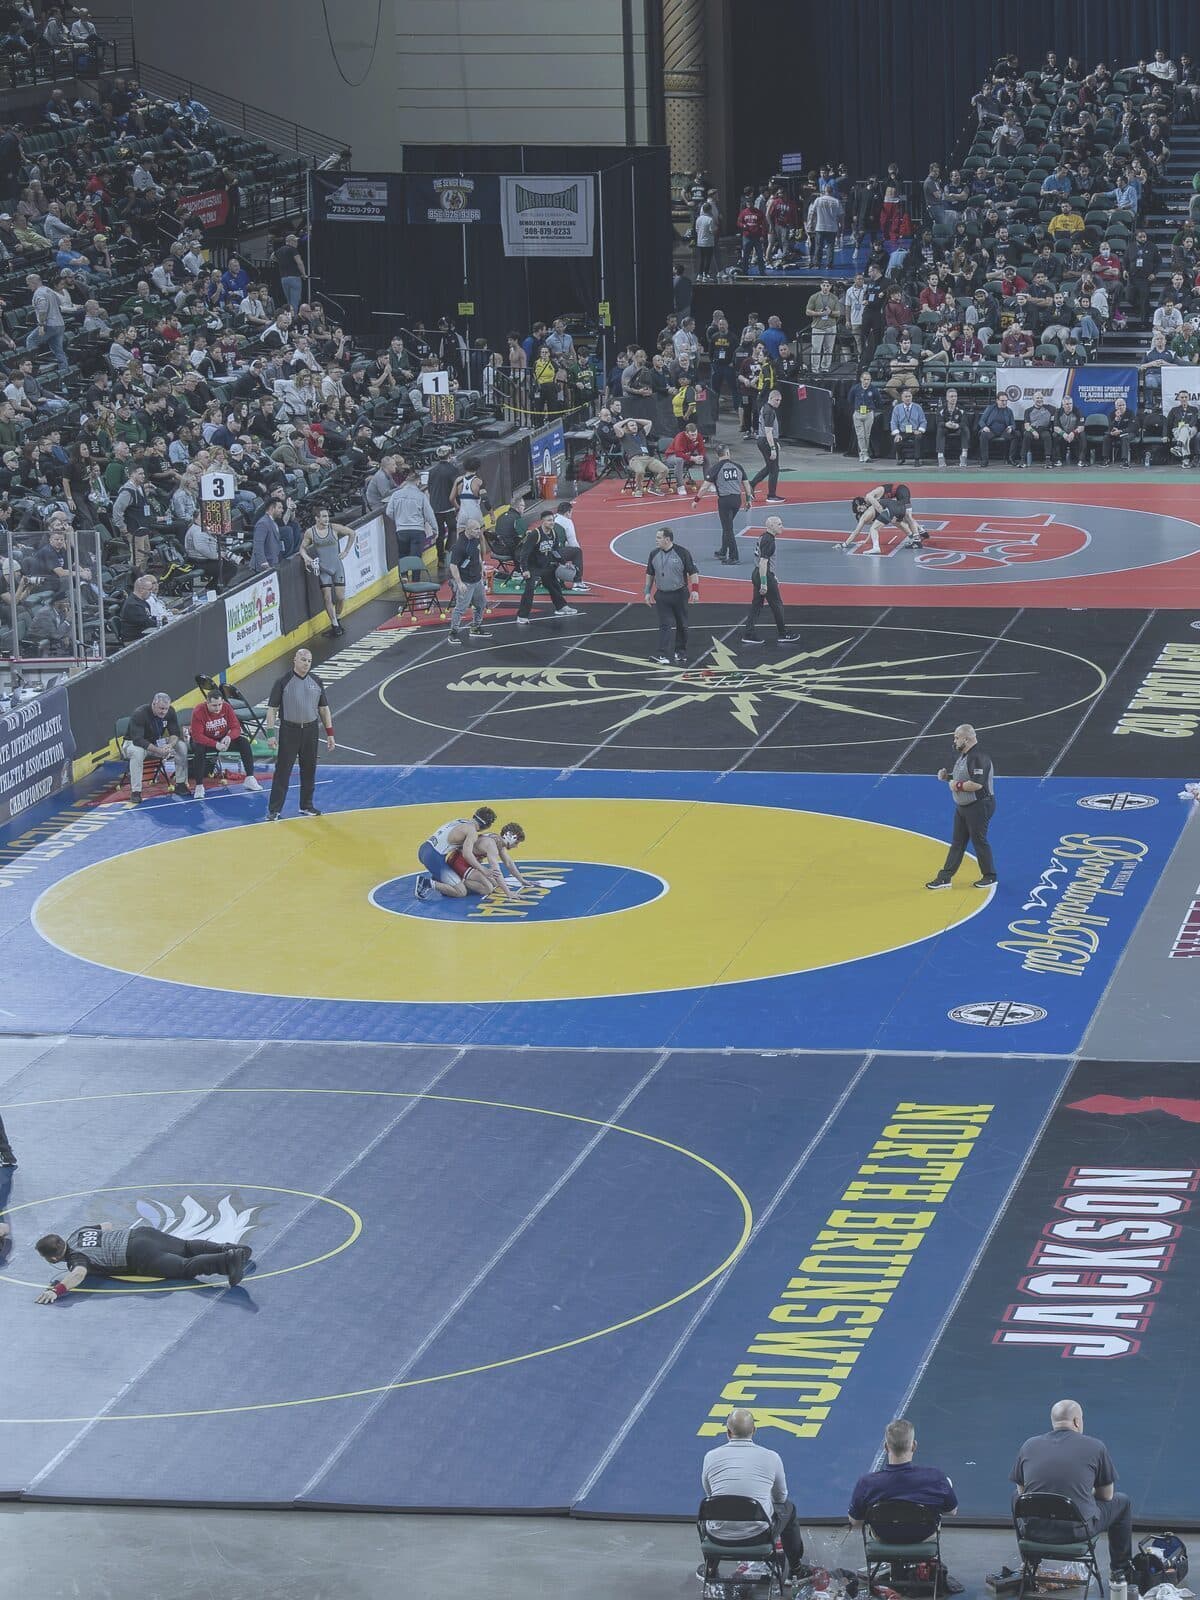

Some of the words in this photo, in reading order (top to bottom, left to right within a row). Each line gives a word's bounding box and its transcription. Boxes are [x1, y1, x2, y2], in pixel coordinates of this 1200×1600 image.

[432, 376, 440, 392] 1
[212, 477, 225, 498] 3
[723, 469, 738, 480] 614
[6, 711, 21, 732] NEW
[20, 700, 42, 729] JERSEY
[1112, 712, 1200, 738] 102
[11, 713, 63, 759] INTERSCHOLASTIC
[25, 741, 65, 779] ASSOCIATION
[9, 775, 53, 816] CHAMPIONSHIP
[1047, 833, 1149, 927] Boardwalk
[997, 919, 1100, 977] Hall
[840, 1102, 996, 1203] NORTH
[82, 1230, 98, 1247] 599
[696, 1209, 938, 1438] BRUNSWICK
